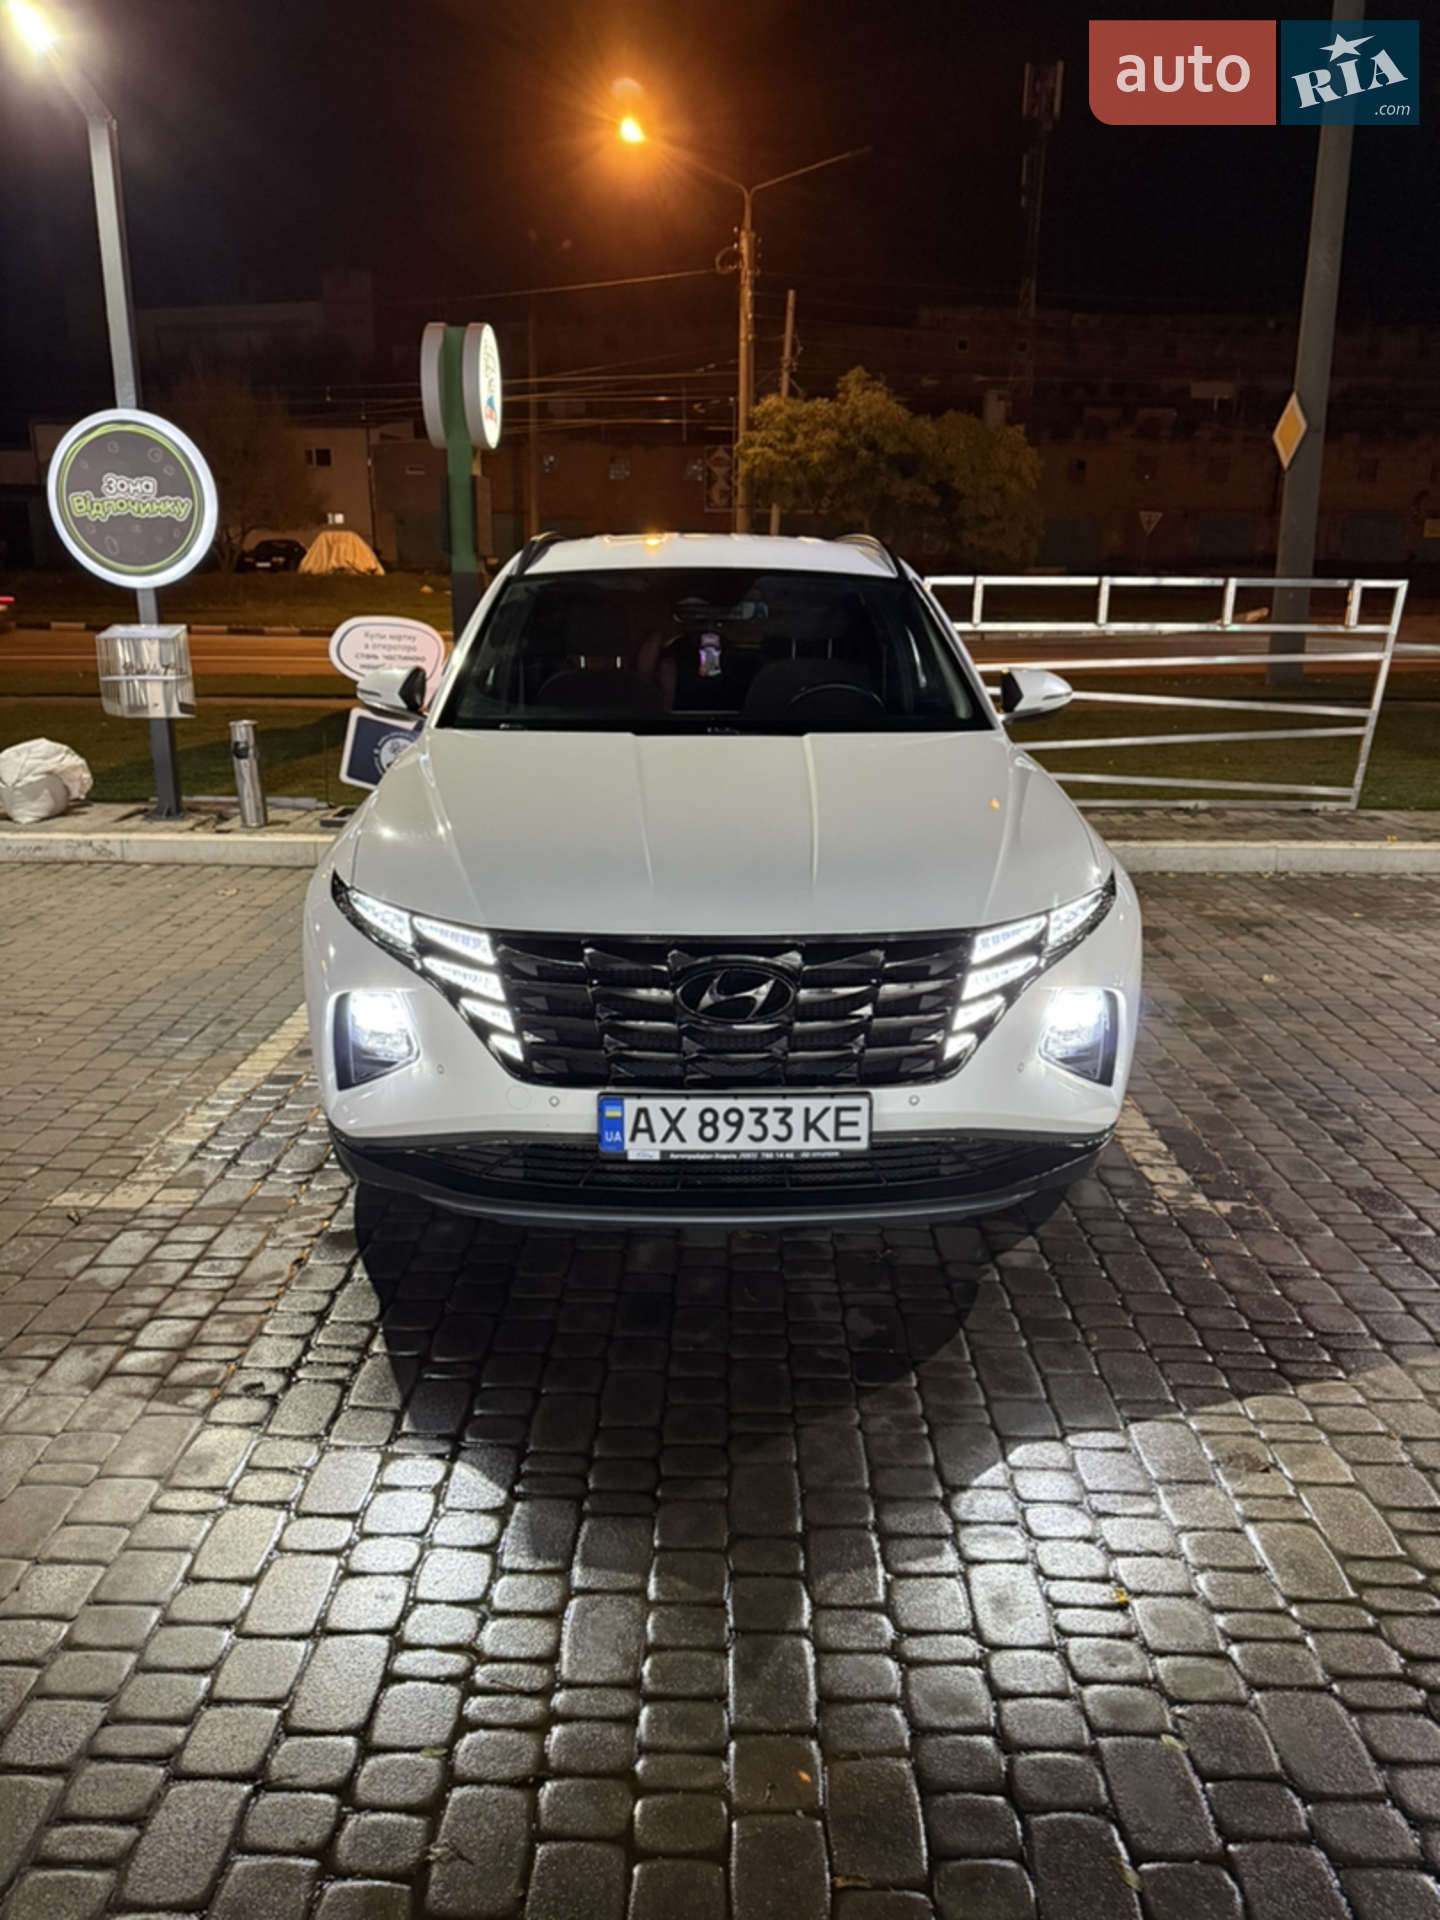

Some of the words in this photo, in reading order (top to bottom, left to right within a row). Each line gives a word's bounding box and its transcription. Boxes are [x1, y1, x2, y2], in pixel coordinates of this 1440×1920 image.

[103, 475, 156, 497] Зона
[70, 492, 191, 520] Відпочинку
[604, 1131, 623, 1143] UA
[628, 1106, 688, 1144] AX
[697, 1106, 794, 1144] 8933
[803, 1105, 862, 1143] KE
